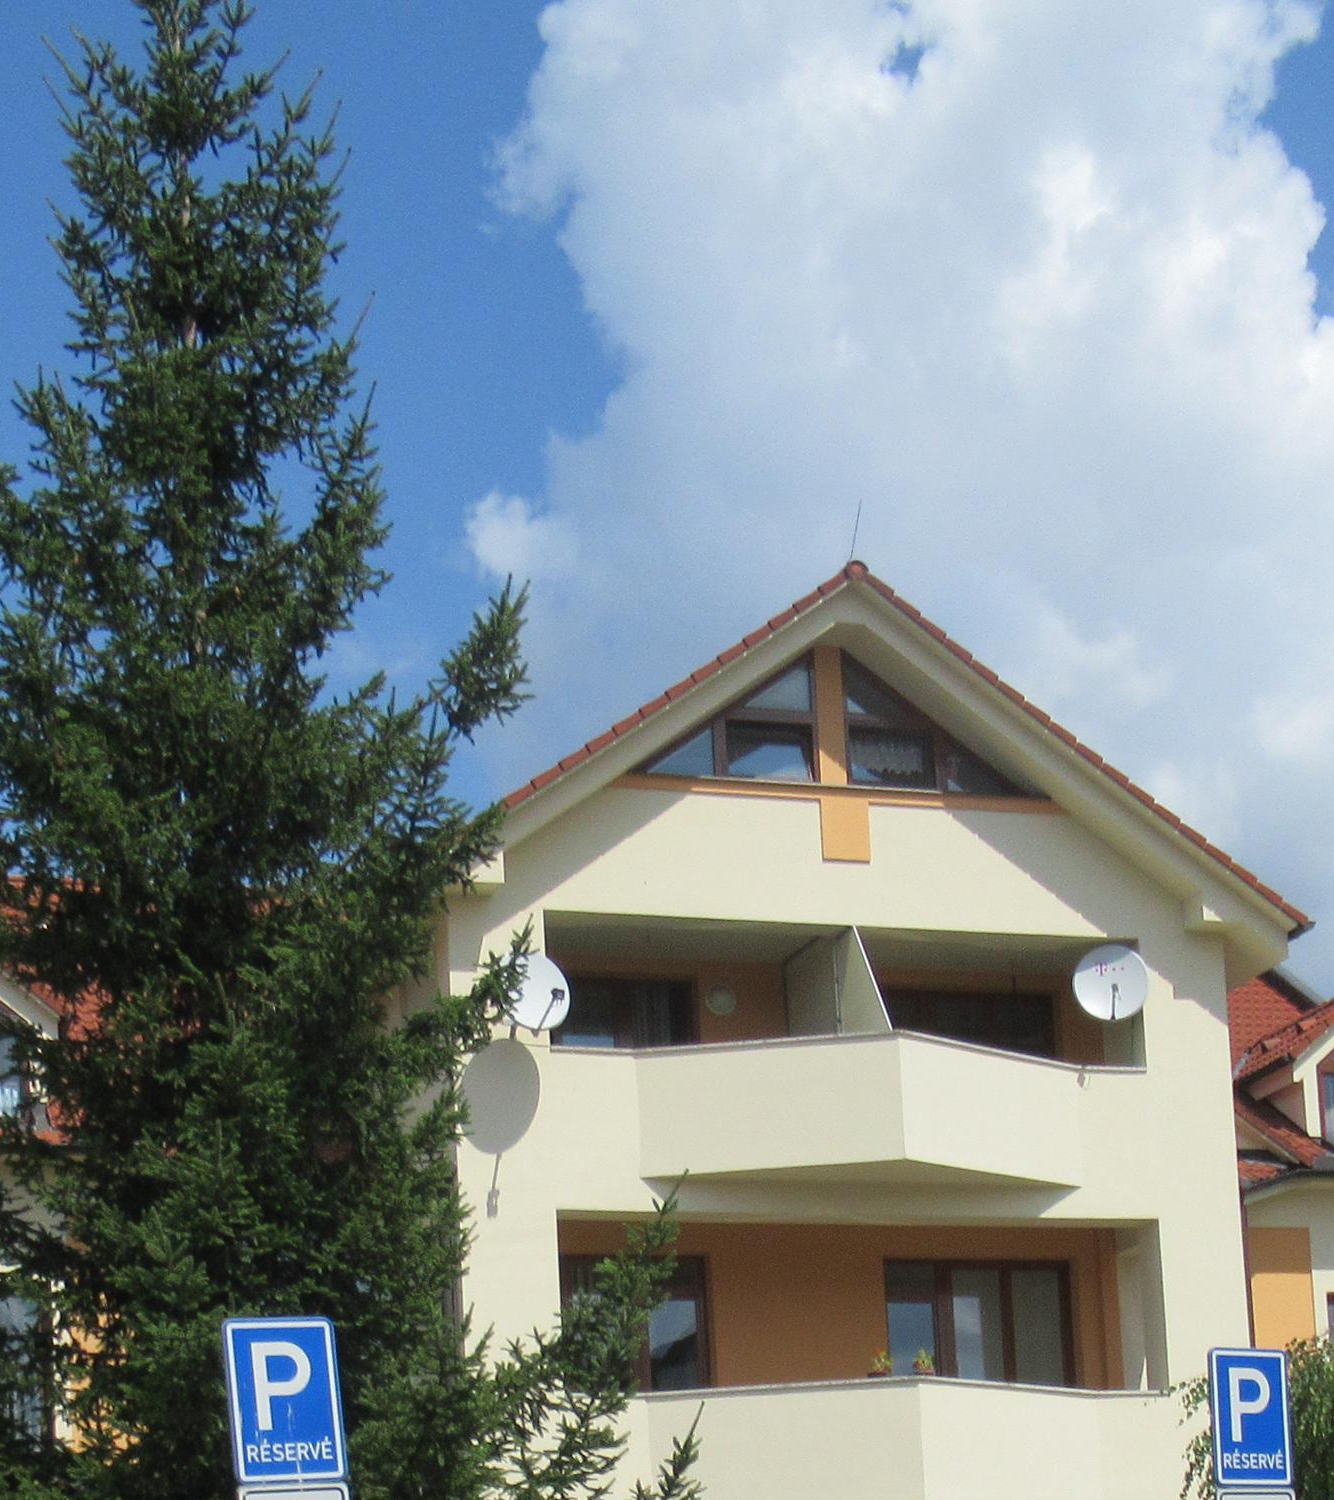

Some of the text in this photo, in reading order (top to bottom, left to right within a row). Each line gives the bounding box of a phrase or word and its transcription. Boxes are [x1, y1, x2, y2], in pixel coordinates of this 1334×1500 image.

[250, 1341, 312, 1431] P
[1228, 1367, 1271, 1443] P
[246, 1436, 333, 1464] RÉSERVÉ
[1223, 1448, 1284, 1470] RÉSERVÉ
